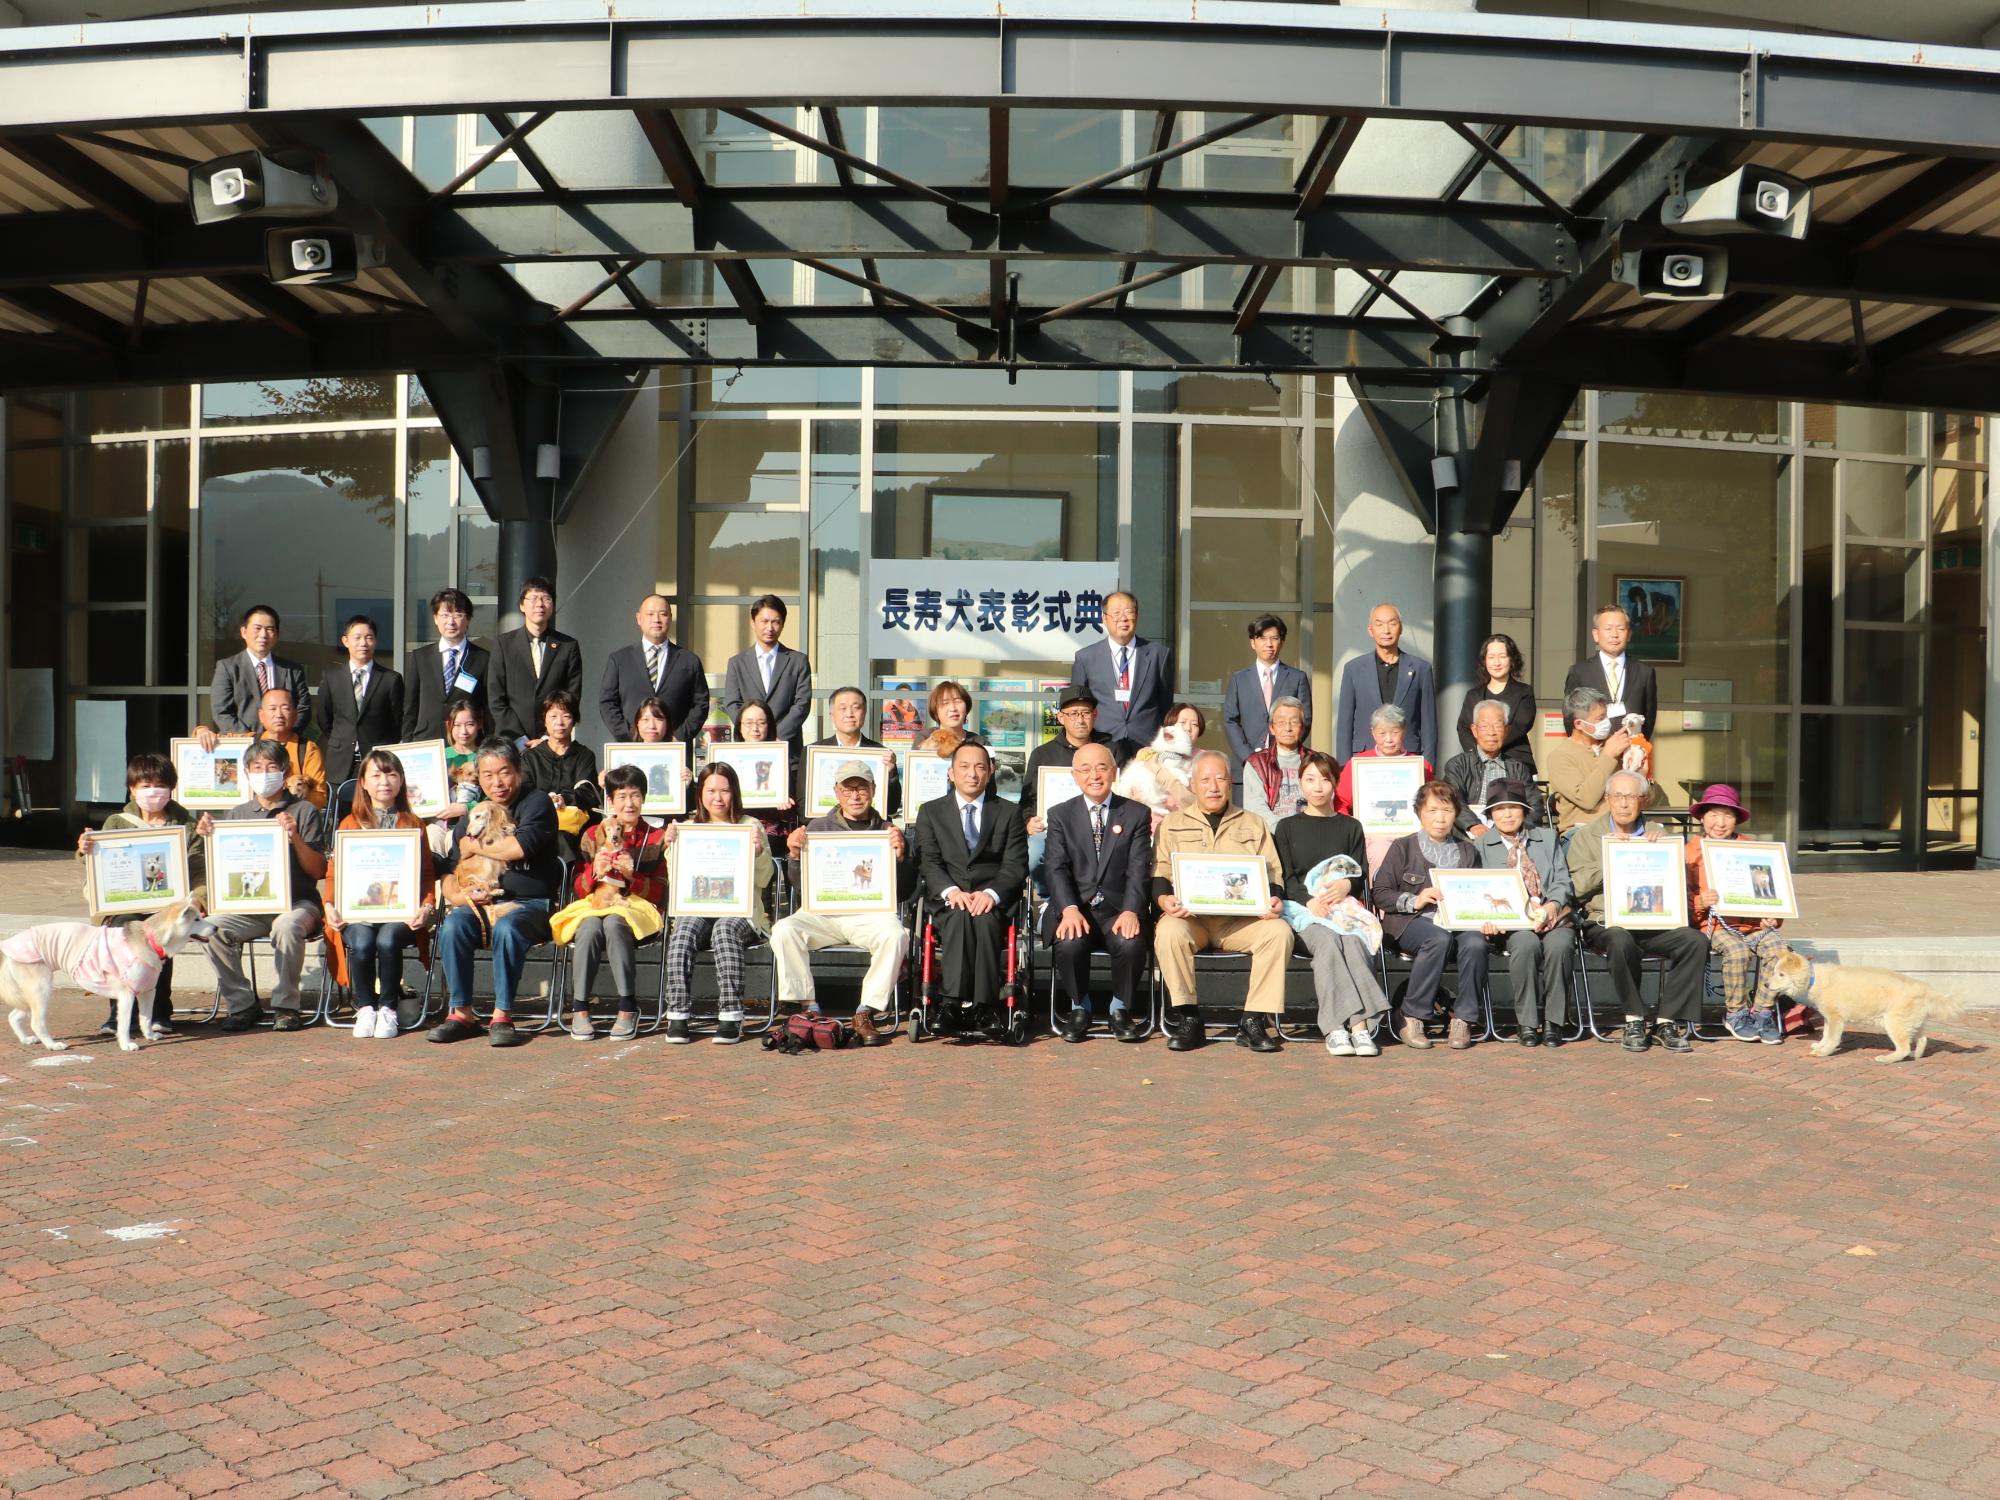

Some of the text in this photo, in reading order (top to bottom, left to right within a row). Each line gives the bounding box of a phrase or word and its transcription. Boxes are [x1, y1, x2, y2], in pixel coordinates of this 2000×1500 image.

[882, 588, 1104, 634] 長寿犬表彰式典
